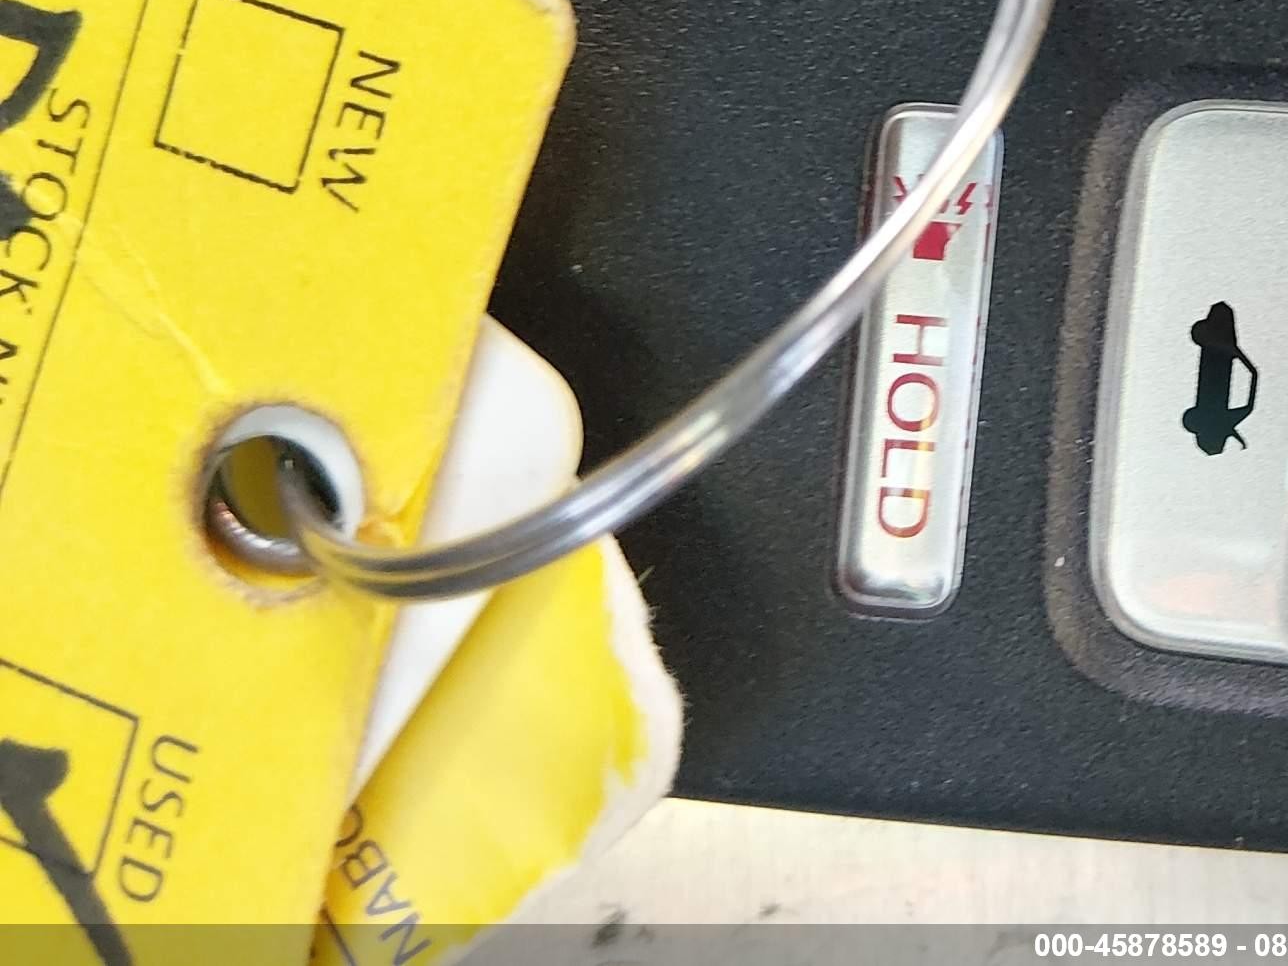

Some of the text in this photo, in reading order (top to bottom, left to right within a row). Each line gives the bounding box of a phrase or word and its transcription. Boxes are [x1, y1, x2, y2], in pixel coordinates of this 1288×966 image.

[0, 88, 90, 315] STOCK
[321, 50, 400, 212] NEW
[877, 314, 946, 539] HOLD
[118, 734, 199, 902] USED
